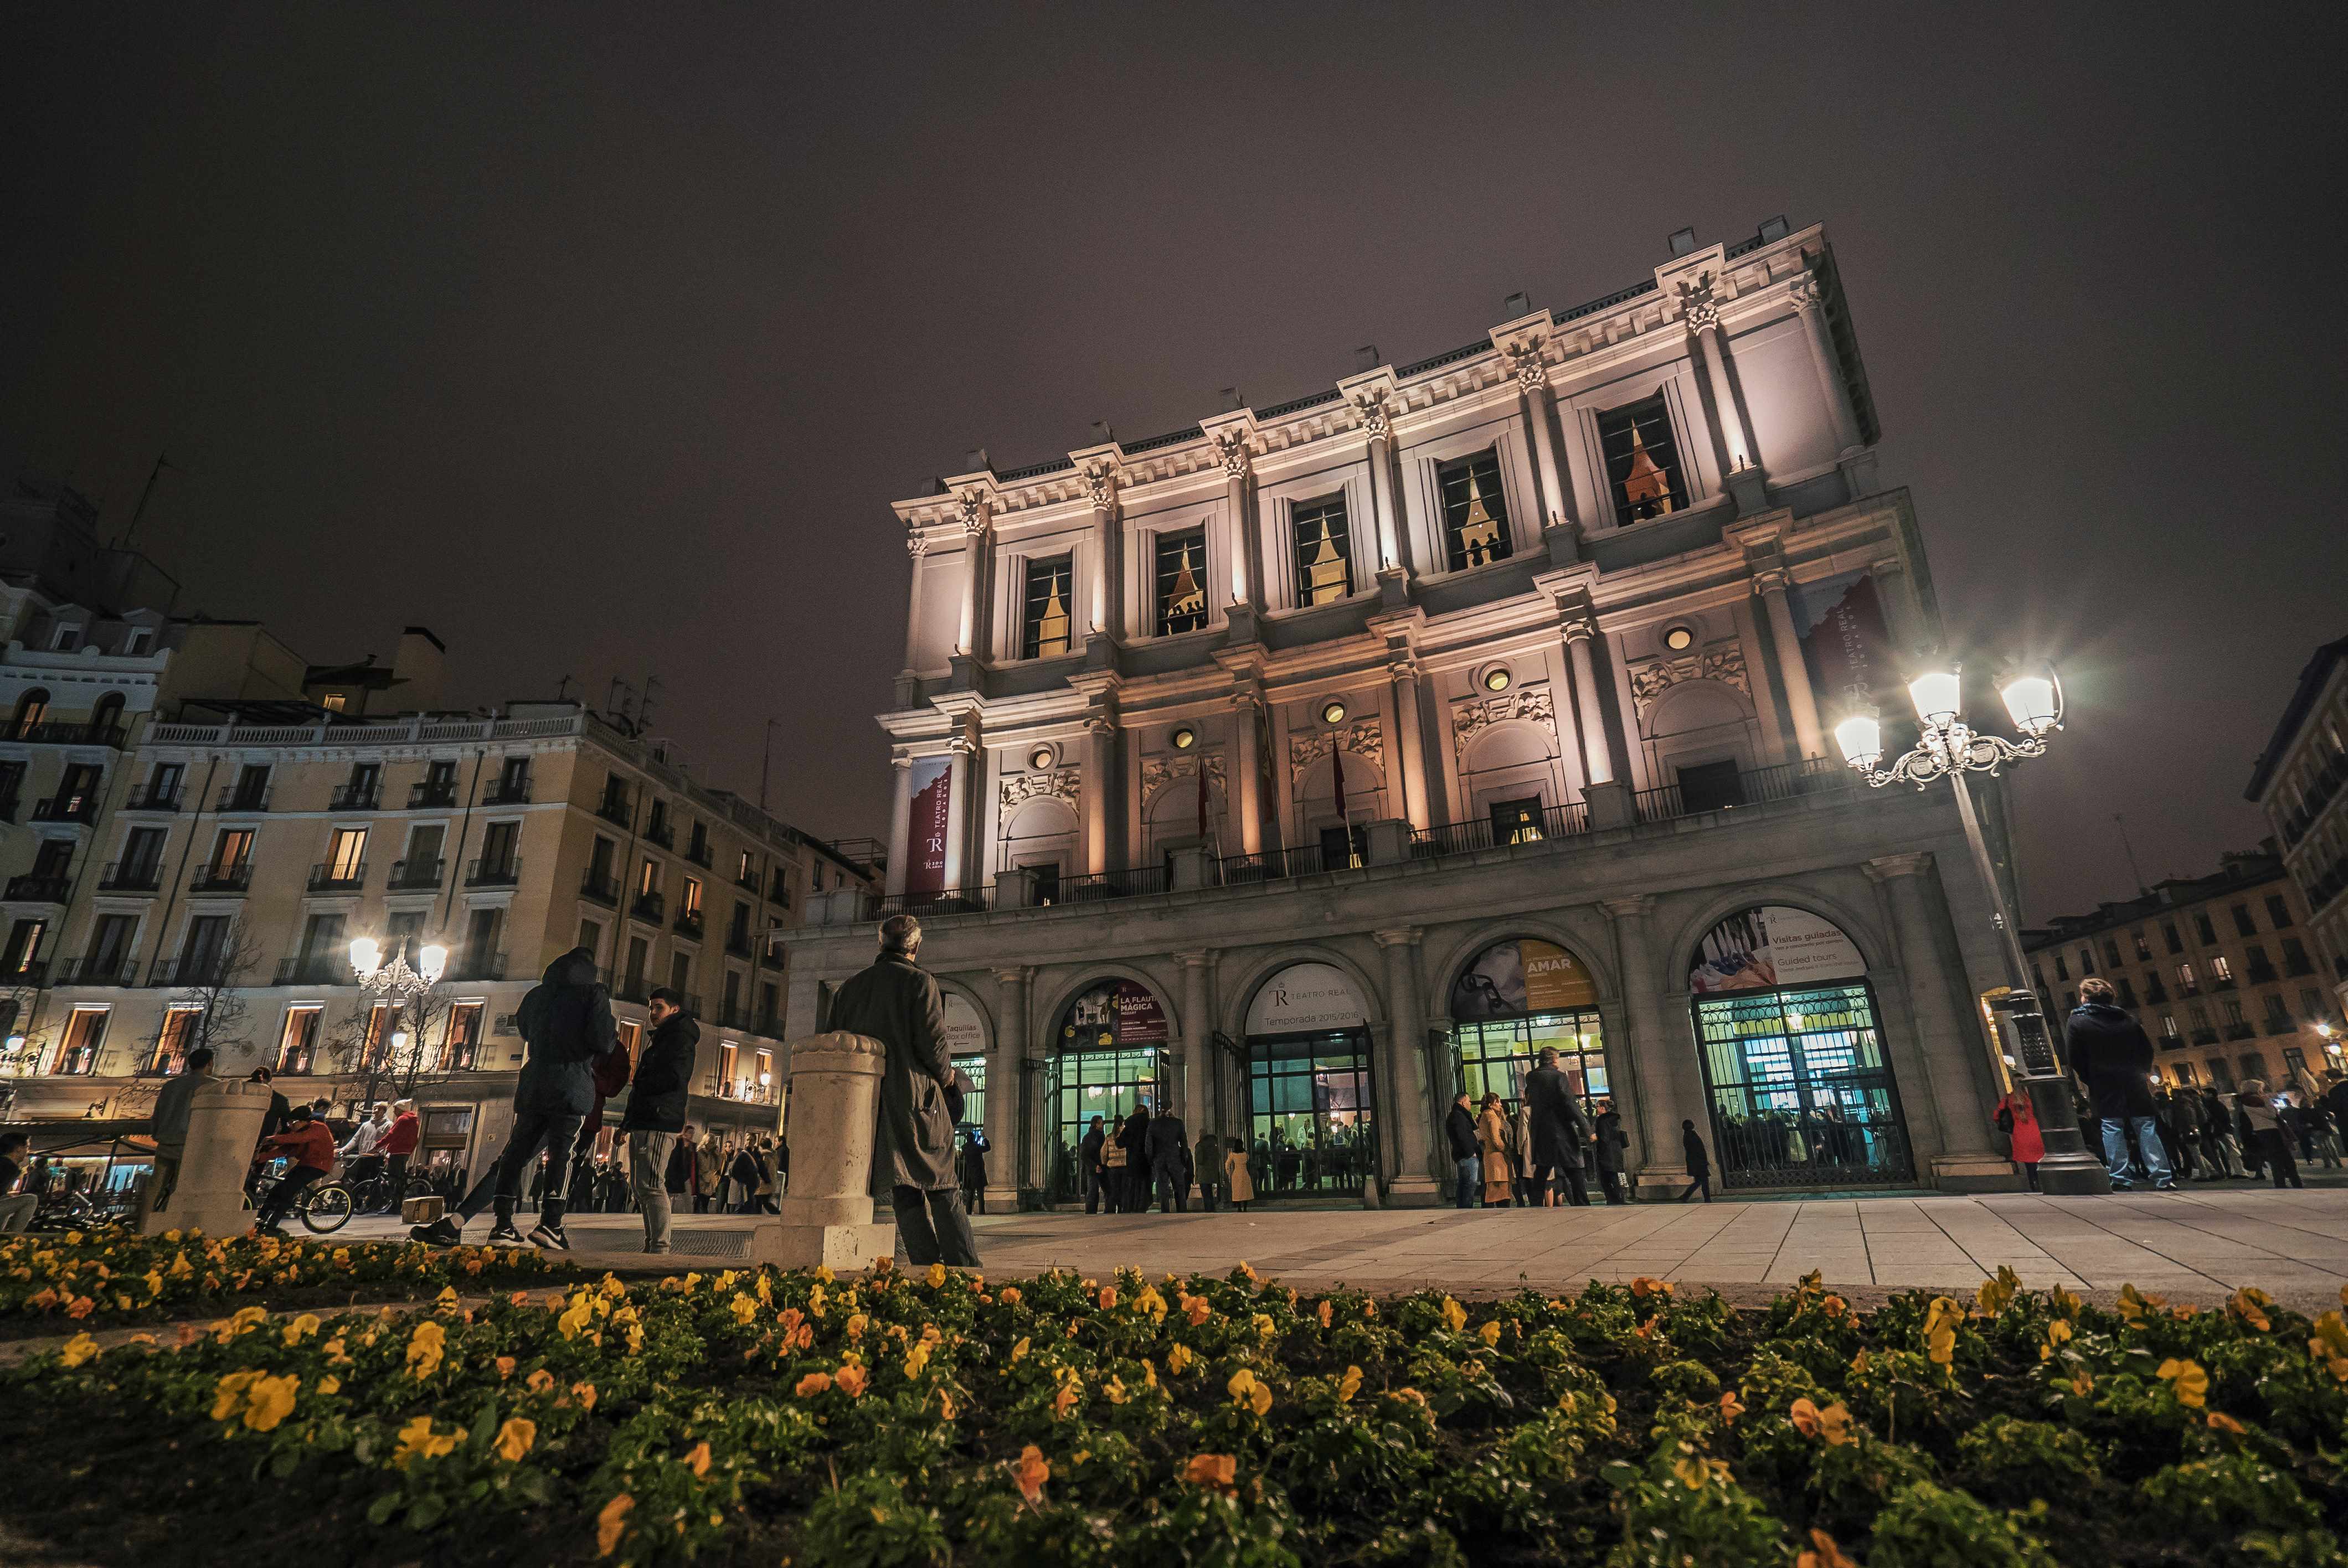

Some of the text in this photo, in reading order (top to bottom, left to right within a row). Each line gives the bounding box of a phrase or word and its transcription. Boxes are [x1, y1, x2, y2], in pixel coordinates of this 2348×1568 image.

[1773, 930, 1841, 944] Visitas guiadas
[1527, 958, 1572, 973] AMAR
[1778, 956, 1810, 966] Guided
[1813, 953, 1837, 962] tours
[1291, 991, 1325, 1000] TEATRO
[1329, 988, 1350, 997] REAL
[1121, 1003, 1153, 1012] MÁGICA
[1265, 1011, 1360, 1027] Temporada 2015/2016
[947, 1024, 977, 1032] Taquillas
